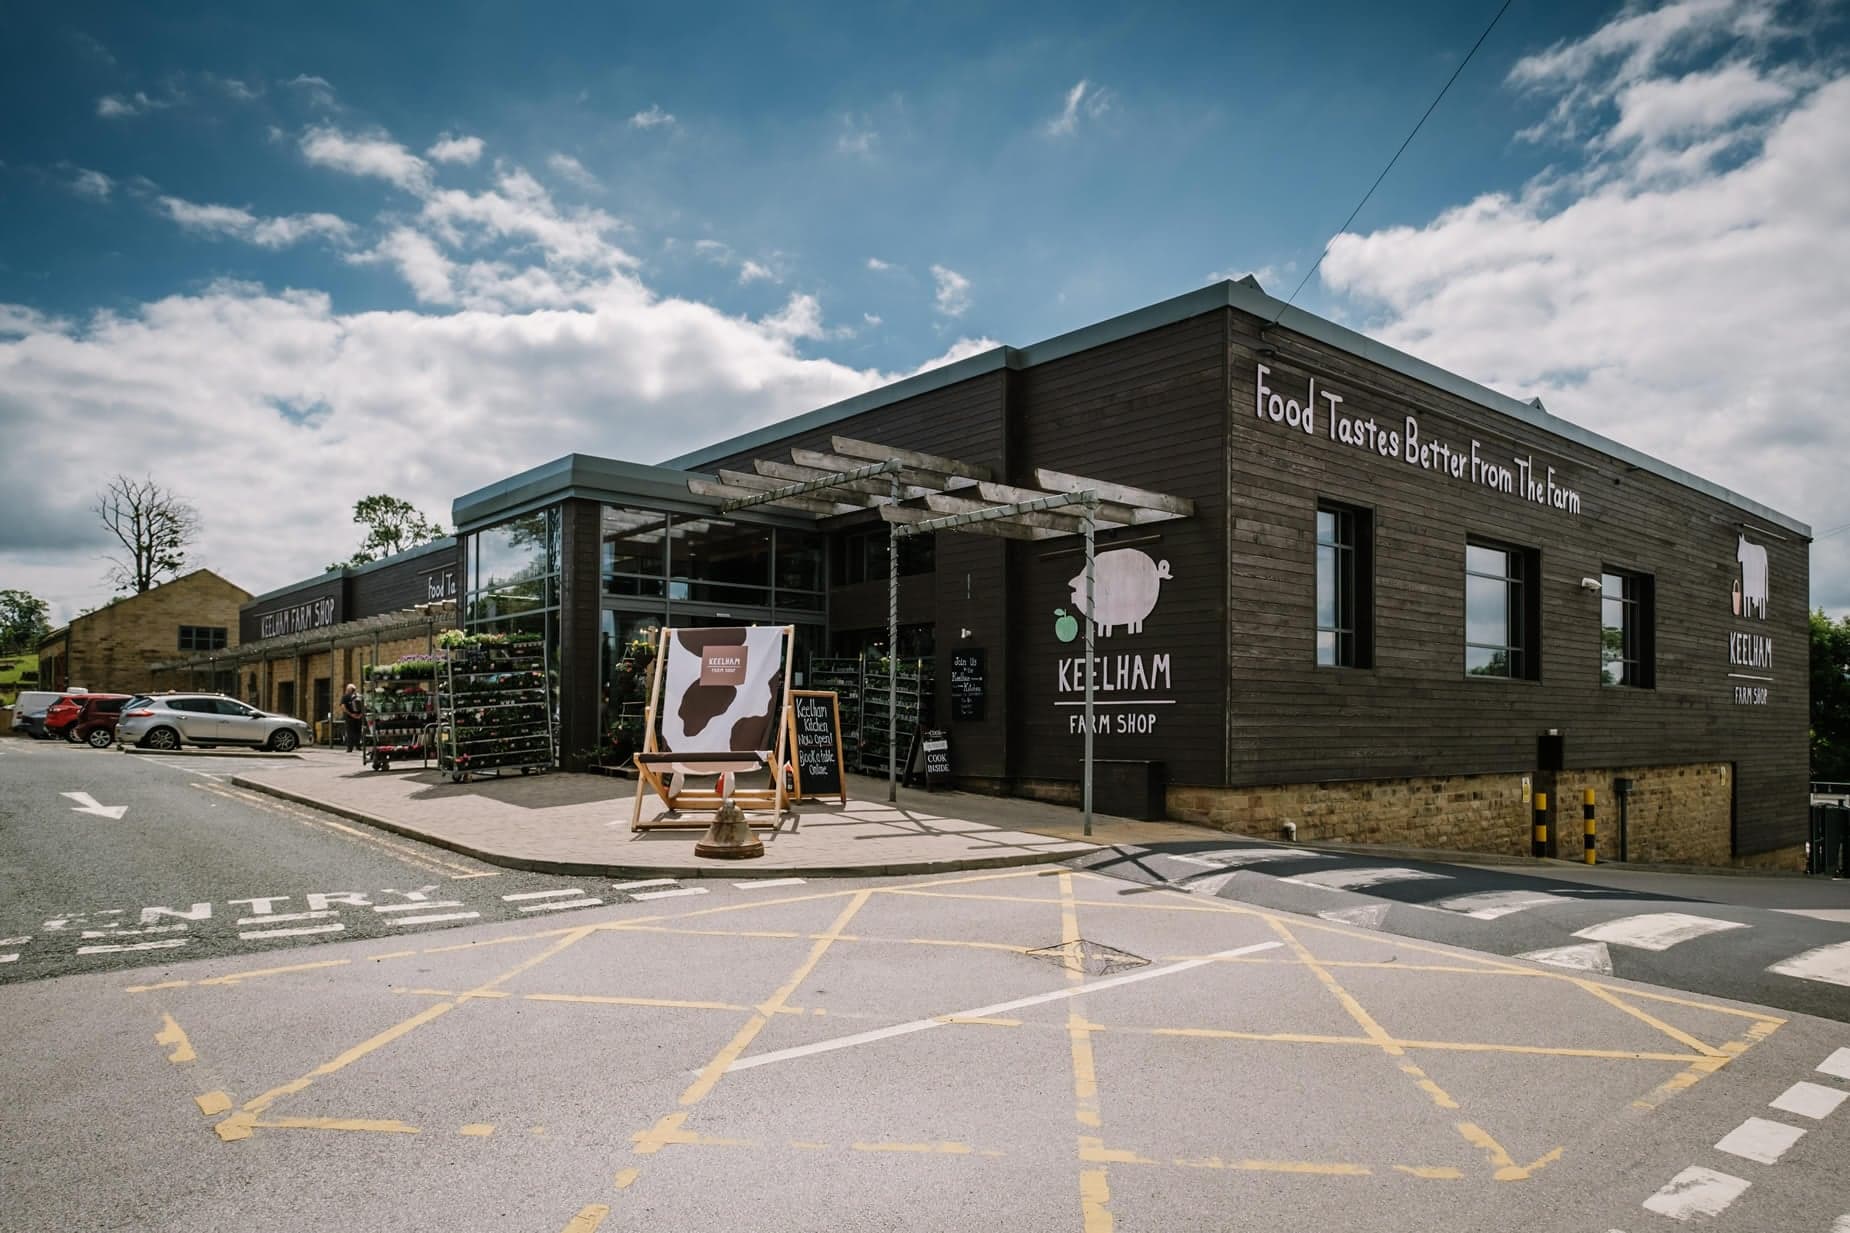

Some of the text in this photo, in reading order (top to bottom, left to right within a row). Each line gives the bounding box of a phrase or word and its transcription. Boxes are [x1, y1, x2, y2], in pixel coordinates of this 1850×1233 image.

[1256, 363, 1581, 515] Food Tastes Better From The Farm
[428, 570, 445, 600] Food
[291, 604, 312, 633] FARM
[314, 598, 335, 627] SHOP
[1730, 631, 1772, 669] KEELHAM
[709, 657, 741, 665] KEELHAM
[1735, 686, 1768, 705] FARM SHOP
[796, 698, 827, 718] Keelham
[804, 718, 828, 732] Kitchen
[1116, 712, 1157, 734] SHOP
[928, 753, 947, 763] COOK
